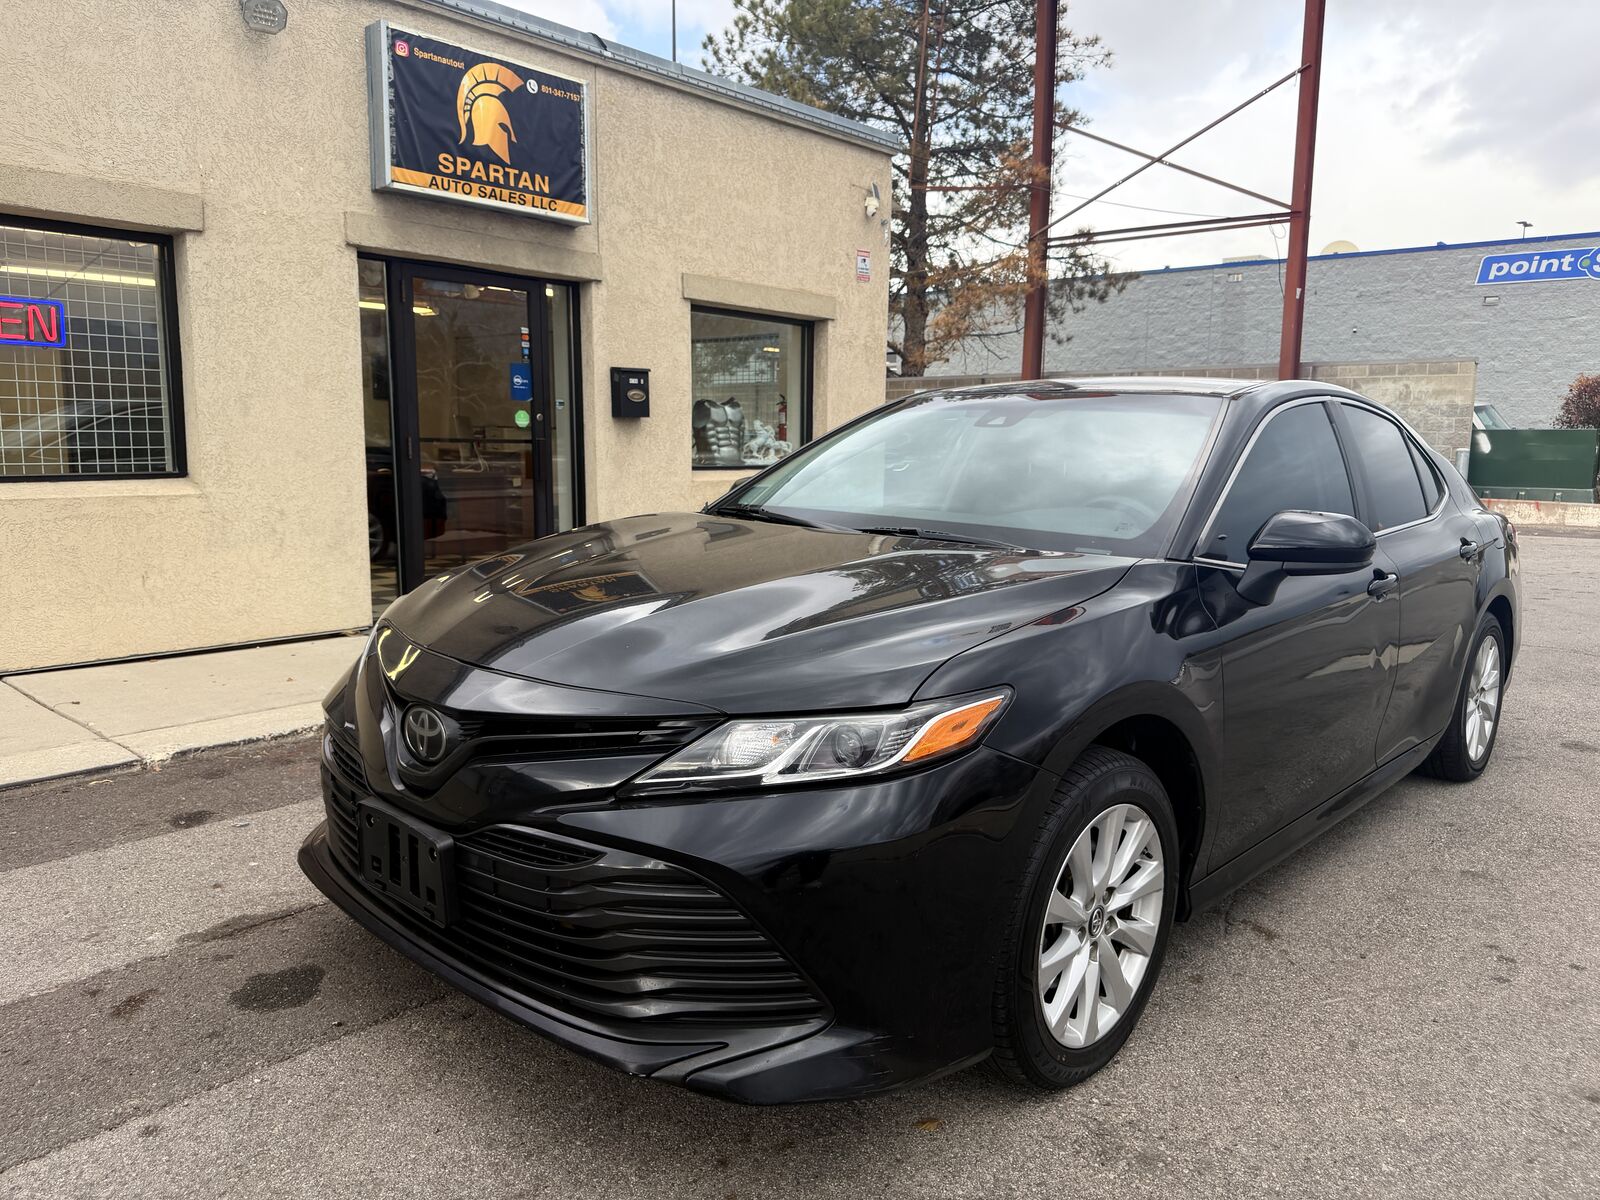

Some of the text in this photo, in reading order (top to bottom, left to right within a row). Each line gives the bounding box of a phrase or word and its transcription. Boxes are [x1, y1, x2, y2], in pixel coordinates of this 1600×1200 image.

[438, 153, 550, 194] SPARTAN
[429, 176, 558, 212] AUTO SALES LLC
[1488, 254, 1575, 280] point
[0, 302, 57, 342] EN
